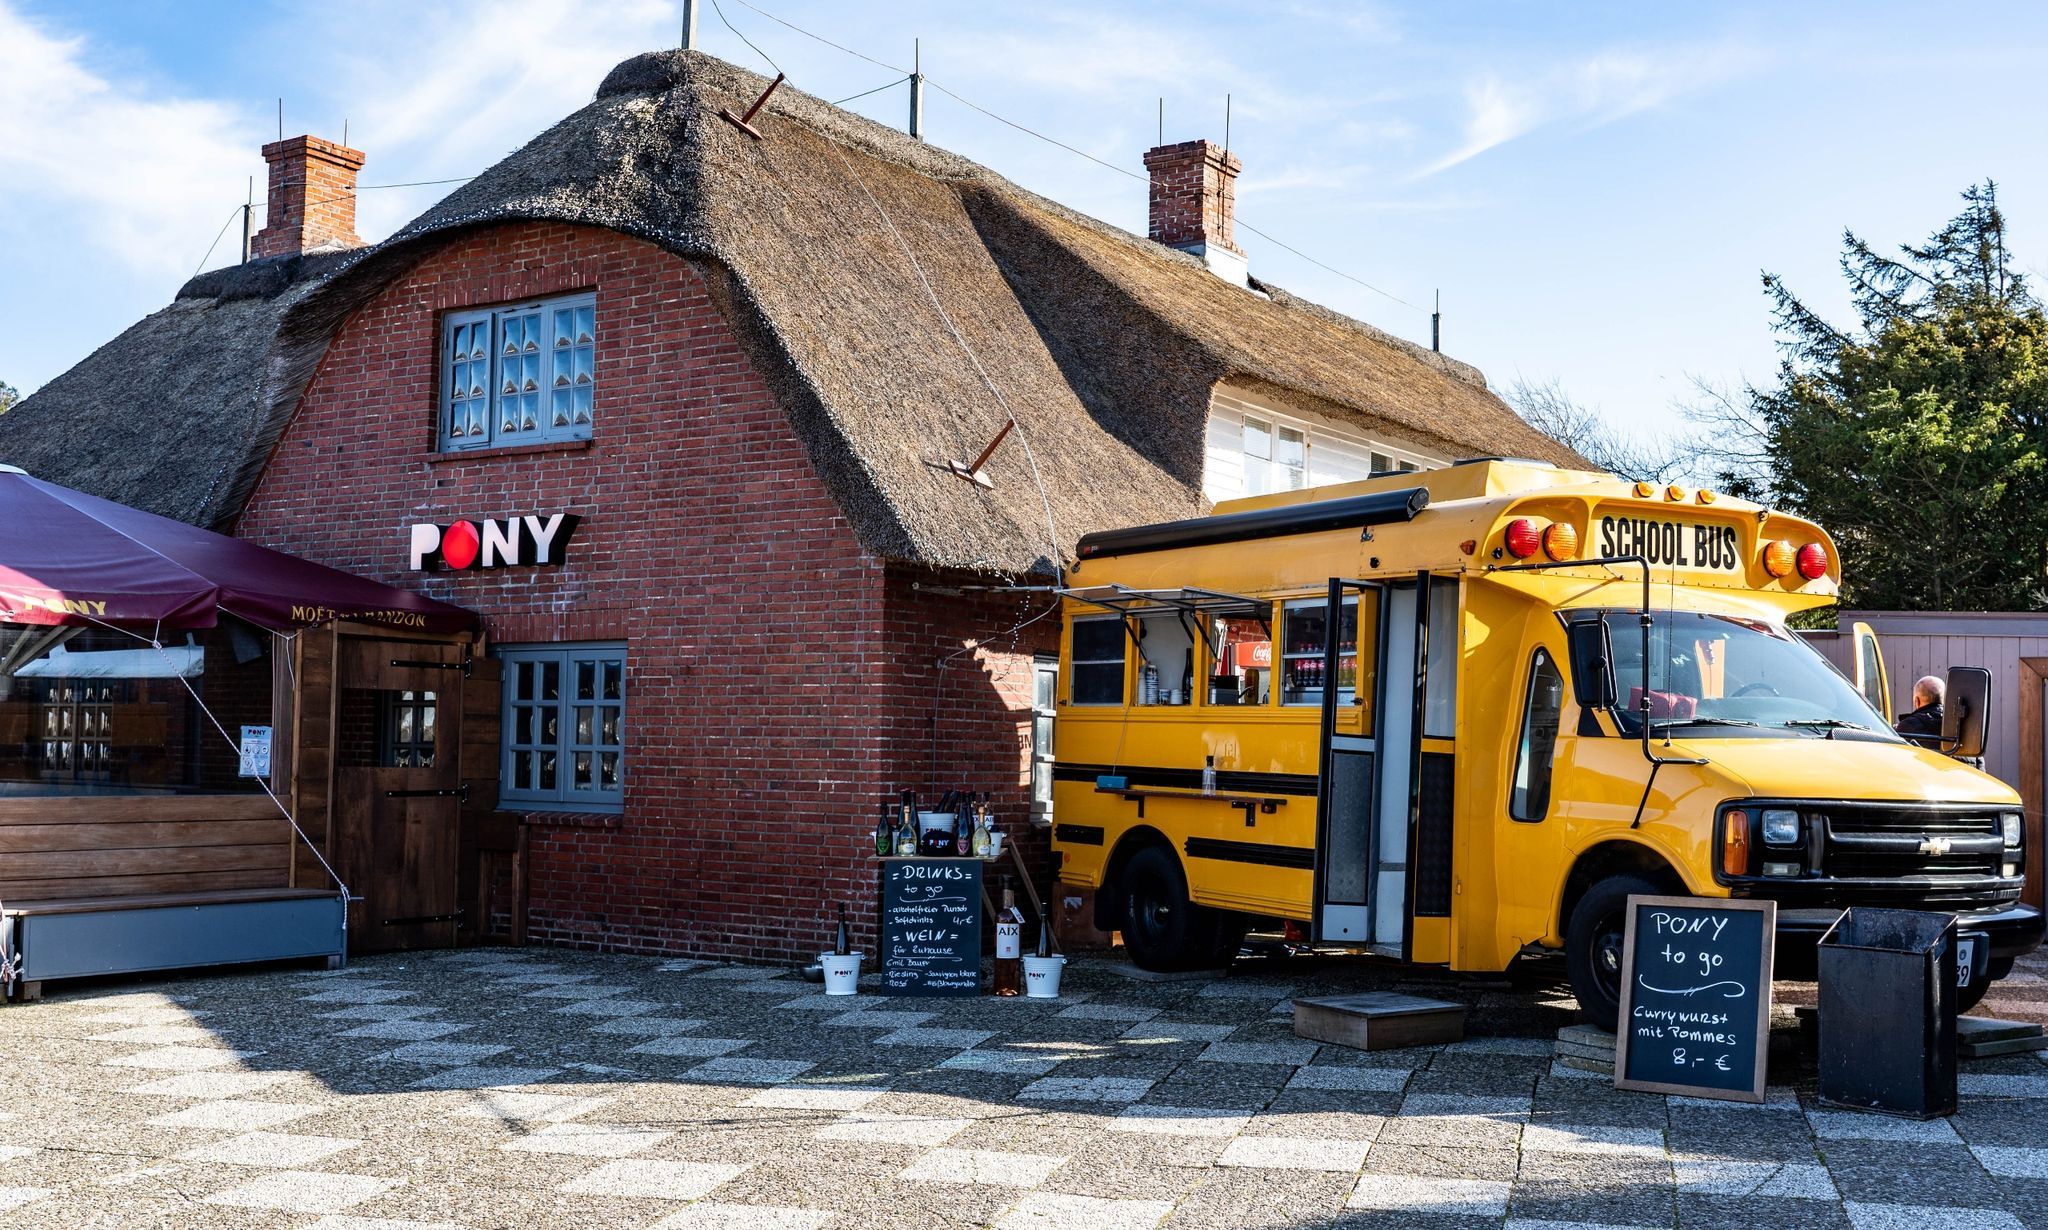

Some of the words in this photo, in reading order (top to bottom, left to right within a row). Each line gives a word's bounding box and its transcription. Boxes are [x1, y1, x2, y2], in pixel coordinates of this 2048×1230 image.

[410, 513, 570, 571] PONY
[1601, 515, 1688, 566] SCHOOL
[1694, 524, 1736, 570] BUS
[905, 884, 918, 893] to
[925, 885, 943, 898] go
[905, 929, 947, 942] WEIN
[998, 927, 1019, 936] AIX
[1650, 912, 1728, 941] PONY
[1661, 943, 1686, 964] to
[1699, 952, 1723, 976] go
[1637, 1026, 1664, 1038] mit
[1667, 1026, 1737, 1046] Pommes
